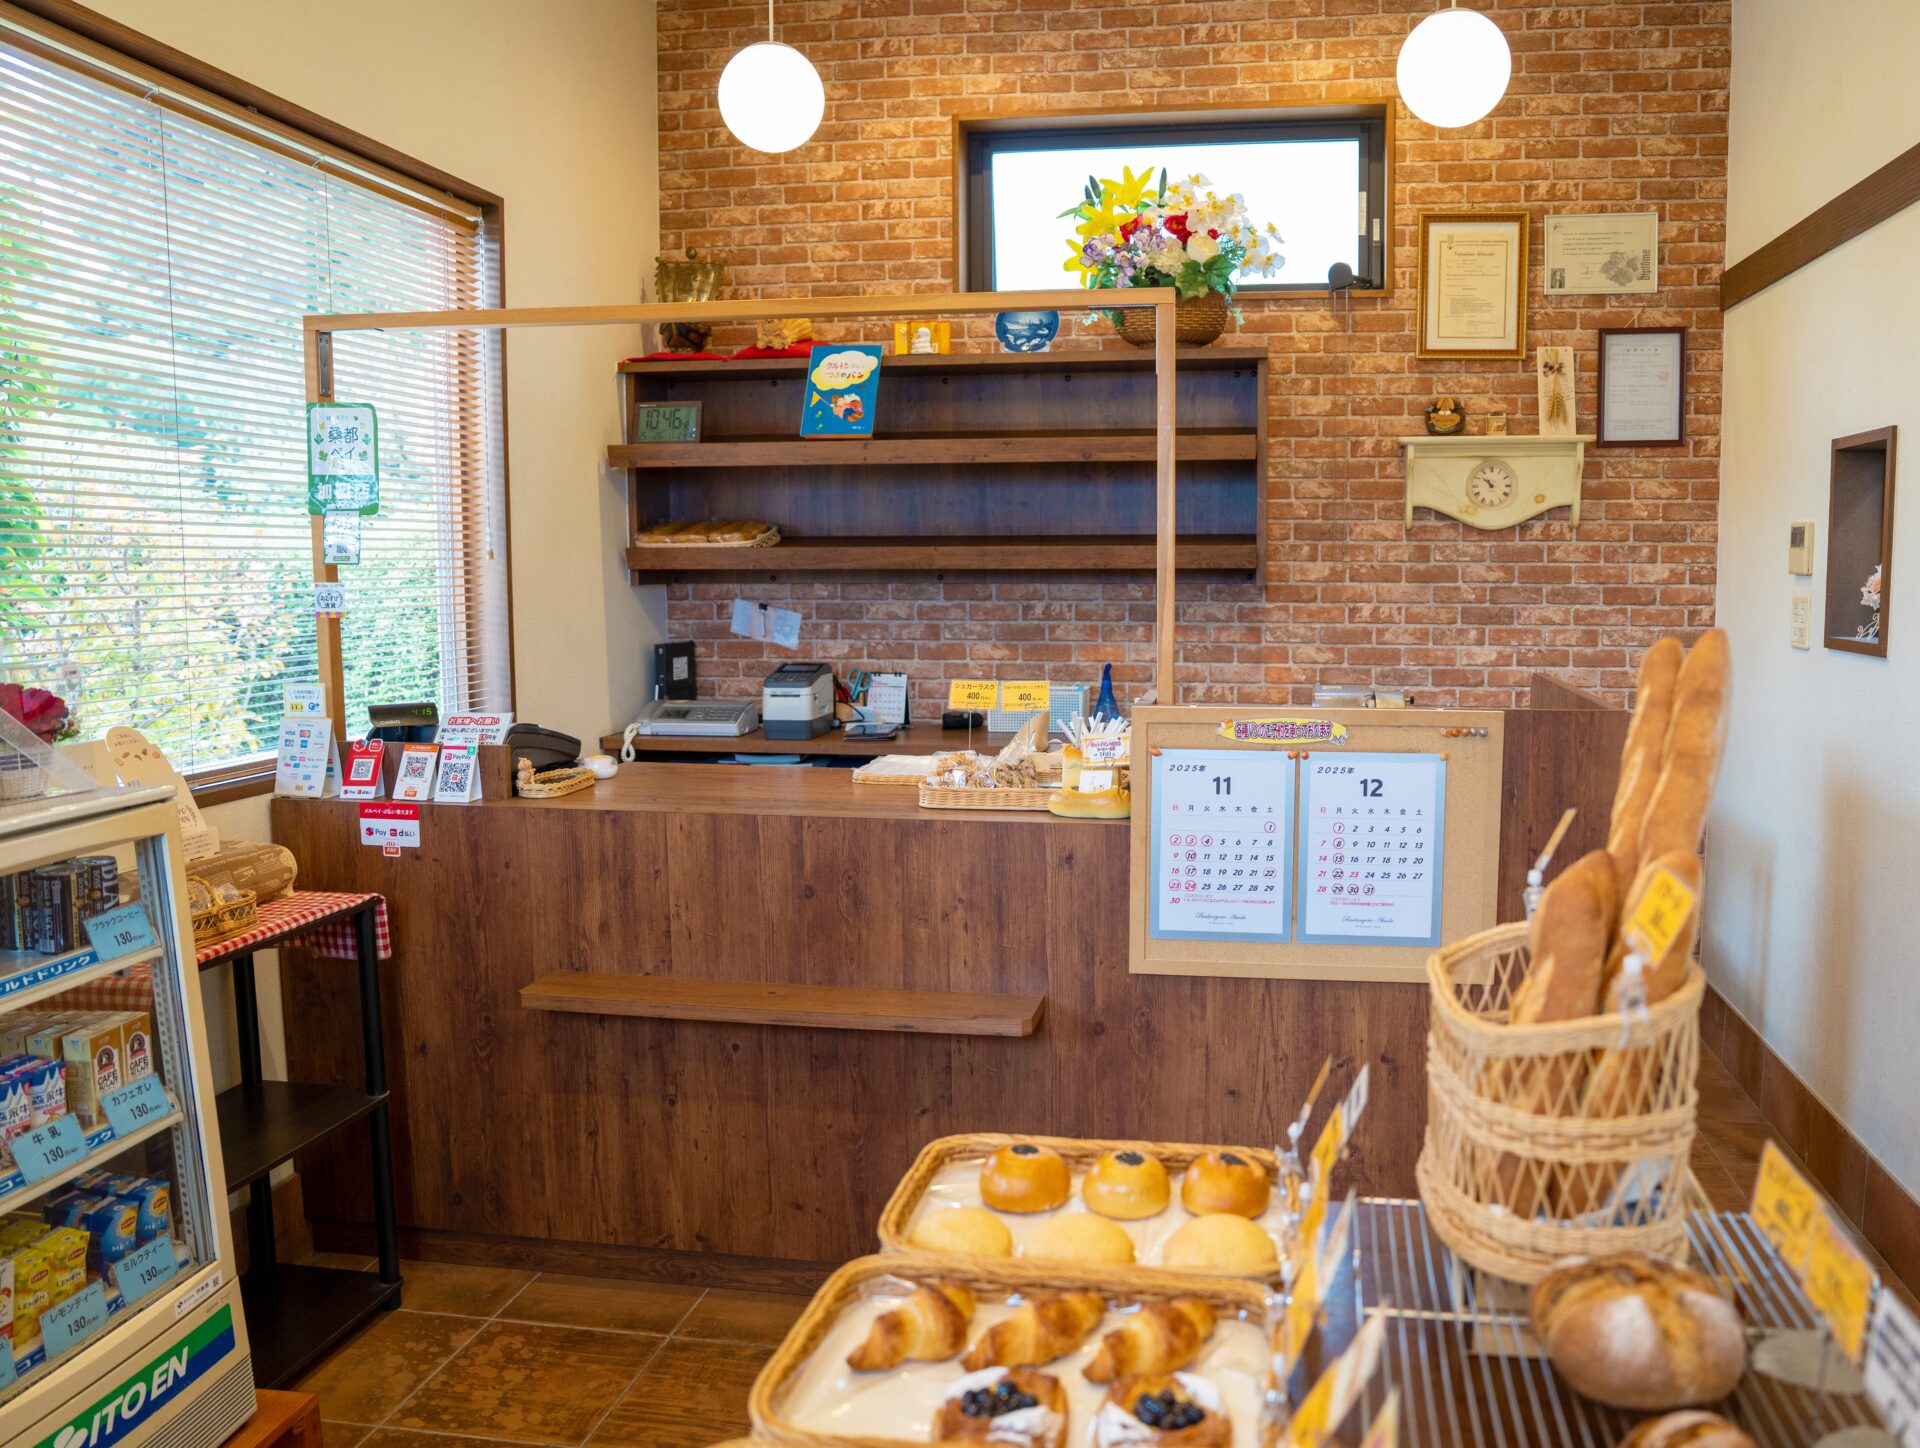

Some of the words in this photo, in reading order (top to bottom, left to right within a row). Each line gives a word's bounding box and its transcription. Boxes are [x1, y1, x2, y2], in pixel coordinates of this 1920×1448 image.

[328, 426, 359, 444] 桑都
[331, 447, 356, 460] ペイ
[1018, 693, 1031, 701] 400
[452, 753, 472, 761] PayPay
[1169, 764, 1206, 772] 2025年
[1317, 766, 1355, 775] 2025年
[1212, 776, 1231, 795] 11
[1359, 778, 1383, 797] 12
[375, 829, 387, 837] Pay
[1264, 869, 1275, 877] 22
[92, 911, 141, 931] ブラックコーヒー
[114, 931, 133, 947] 130
[0, 955, 91, 992] ルドドリンク
[112, 1083, 152, 1107] カフェオレ
[130, 1103, 149, 1120] 130
[32, 1125, 62, 1145] 牛乳
[43, 1146, 65, 1165] 130
[123, 1242, 166, 1272] ミルクティー
[56, 1270, 81, 1287] LEMON
[140, 1266, 158, 1285] 130
[18, 1295, 46, 1311] LEMON
[50, 1289, 98, 1323] レモンティー
[67, 1316, 87, 1337] 130
[90, 1381, 147, 1448] ITO
[150, 1346, 189, 1402] EN
